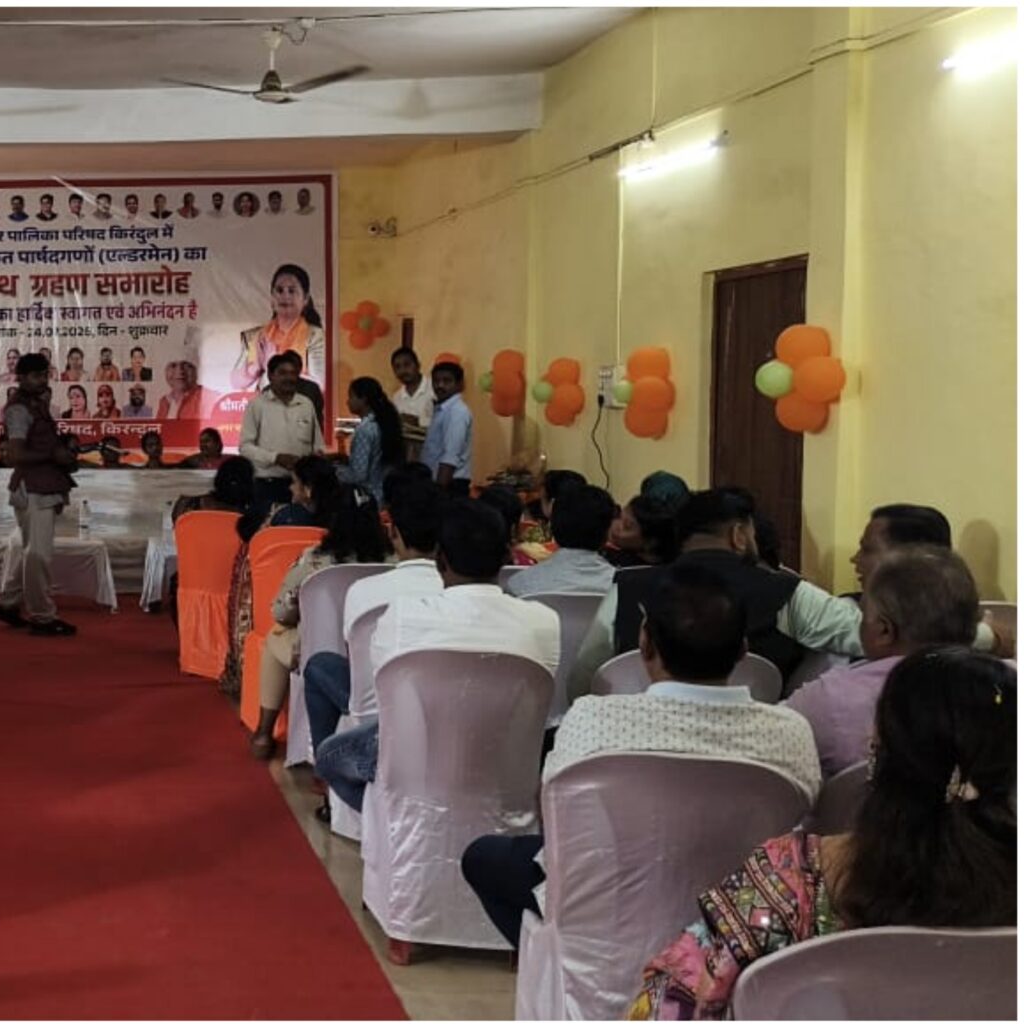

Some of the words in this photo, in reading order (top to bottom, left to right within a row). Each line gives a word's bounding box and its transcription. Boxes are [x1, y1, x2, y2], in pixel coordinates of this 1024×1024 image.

[8, 227, 59, 241] पालिका
[63, 226, 105, 241] परिषद
[109, 225, 159, 244] किरंदुल
[161, 225, 174, 239] में
[18, 245, 95, 264] पार्षदगणों
[98, 243, 180, 265] (एल्डरमेन)
[184, 246, 208, 261] का
[29, 272, 91, 297] ग्रहण
[93, 265, 192, 296] समारोह
[60, 305, 103, 321] स्वागत
[105, 302, 125, 319] एवं
[128, 302, 185, 320] अभिनंदन
[187, 300, 199, 319] है
[55, 422, 97, 437] रिषद,
